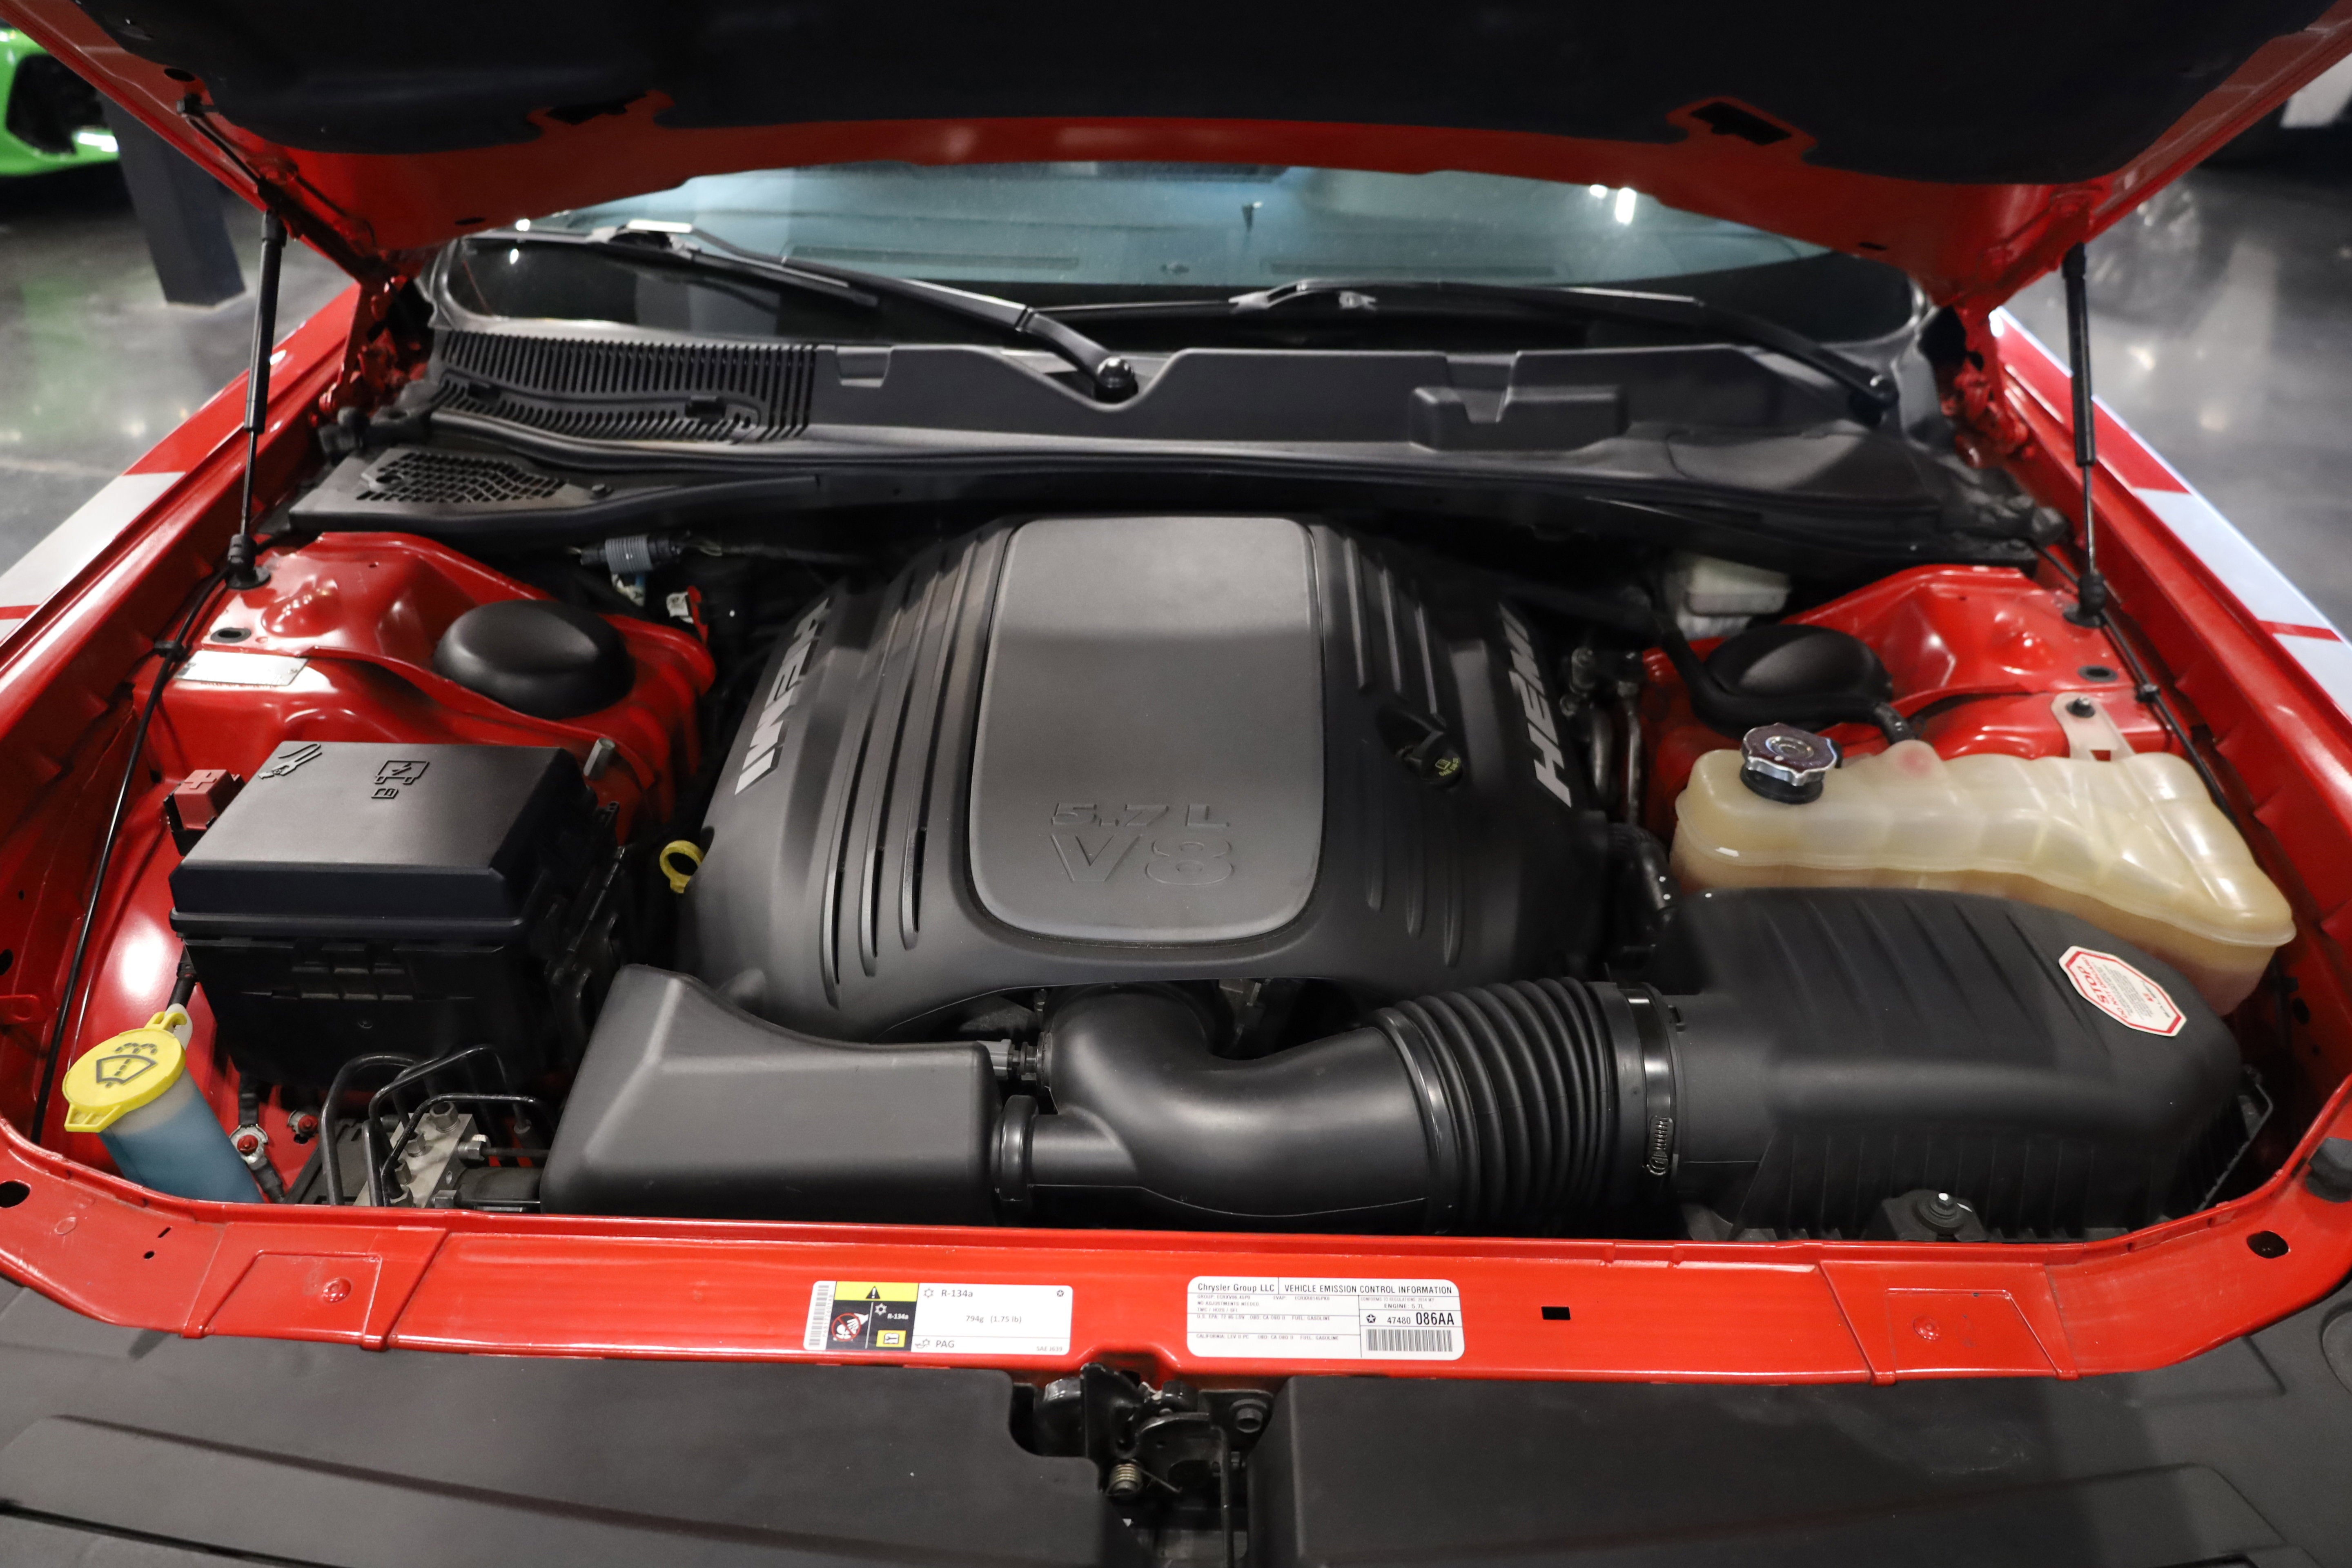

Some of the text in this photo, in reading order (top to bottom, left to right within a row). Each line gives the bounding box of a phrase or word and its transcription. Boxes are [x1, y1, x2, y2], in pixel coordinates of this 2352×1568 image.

[1498, 601, 1571, 808] HEMI
[1051, 833, 1234, 885] V8
[2077, 965, 2109, 1004] STOP
[2105, 990, 2118, 1006] NOT
[2117, 1007, 2128, 1018] DO
[1198, 1283, 1230, 1292] Chrysler
[1233, 1284, 1257, 1293] Group
[1399, 1286, 1452, 1294] INFORMATION
[990, 1315, 1009, 1323] (1.75
[1387, 1312, 1454, 1325] 47480 086AA
